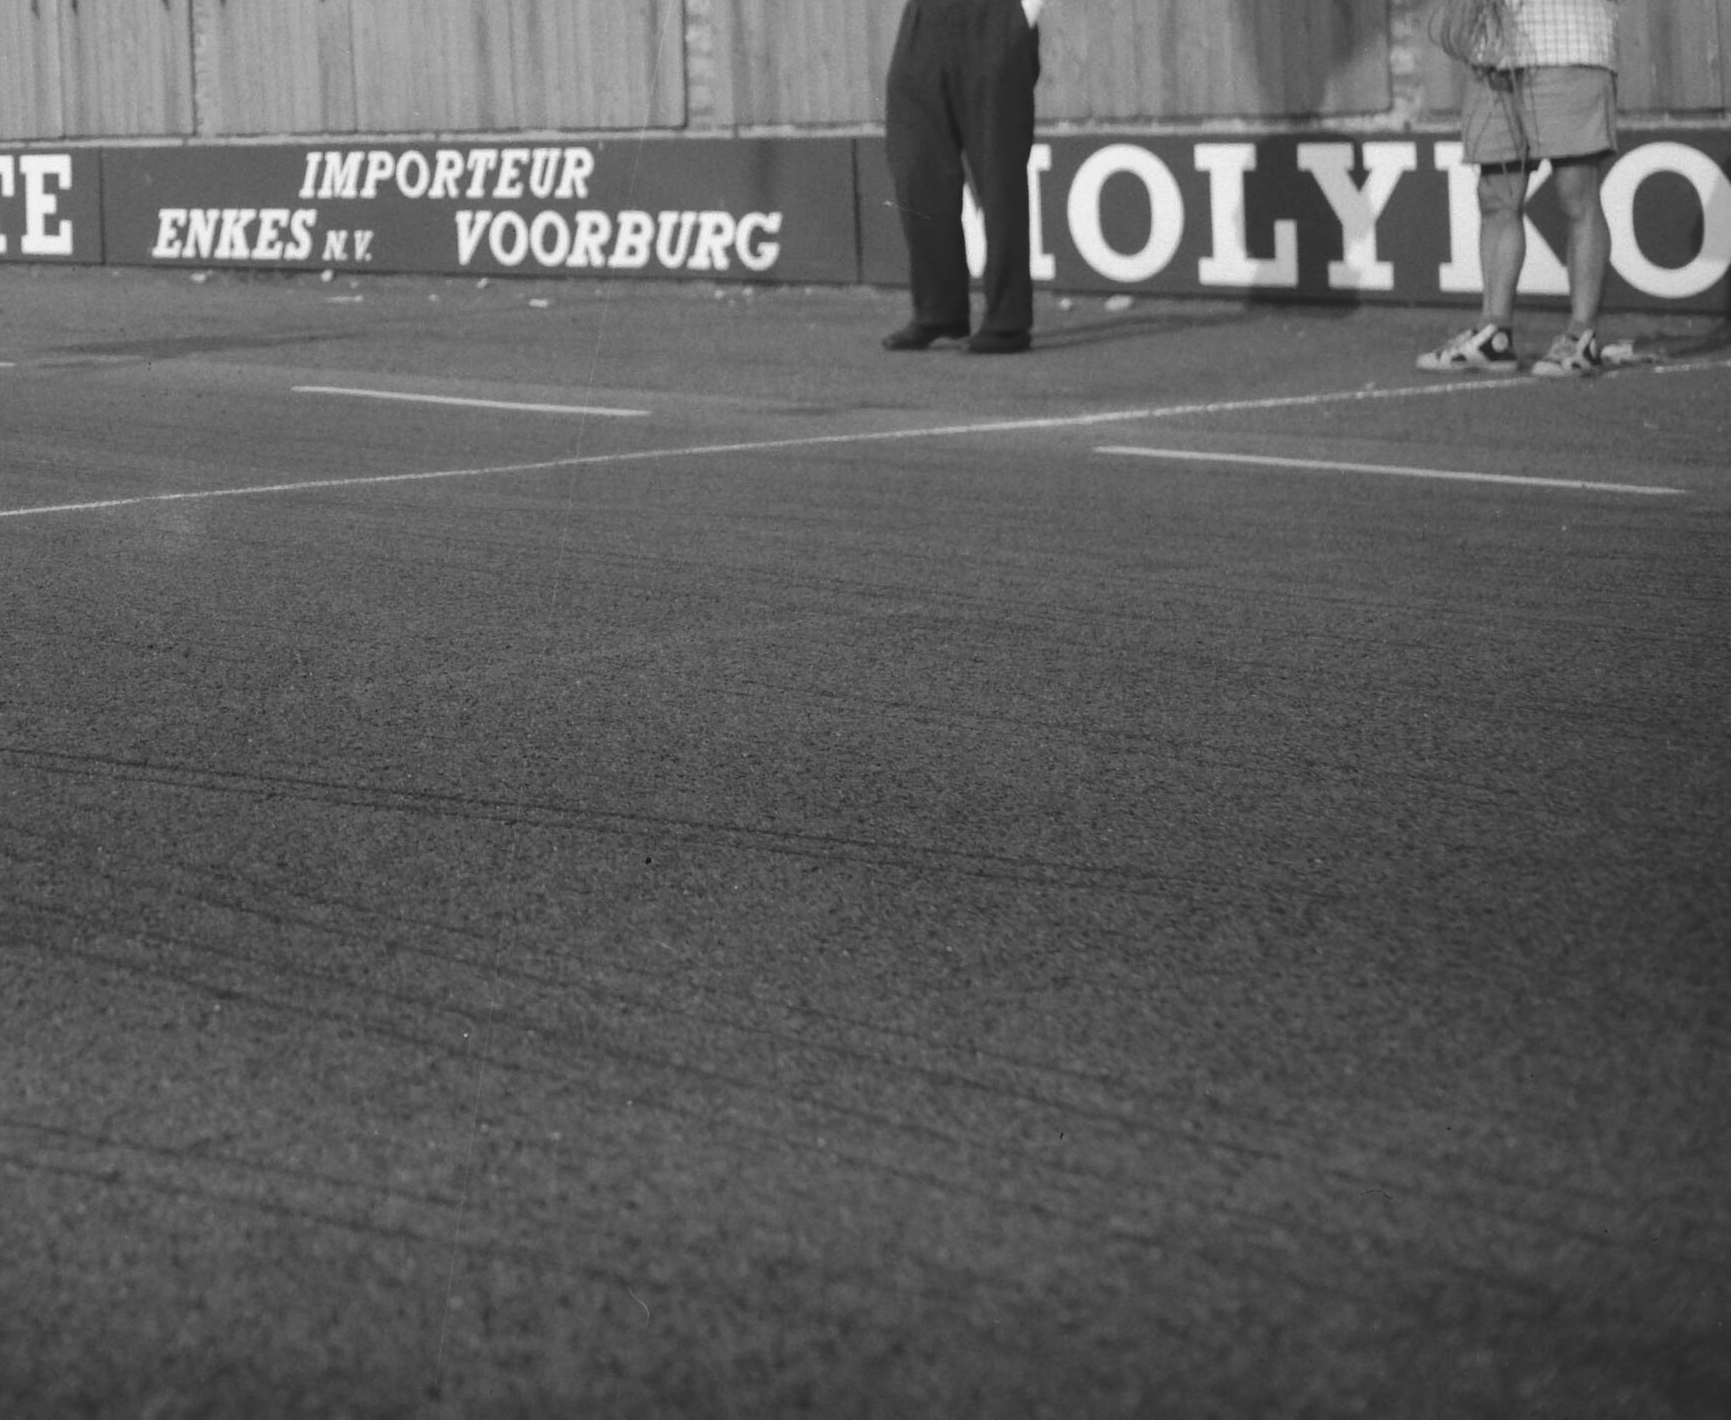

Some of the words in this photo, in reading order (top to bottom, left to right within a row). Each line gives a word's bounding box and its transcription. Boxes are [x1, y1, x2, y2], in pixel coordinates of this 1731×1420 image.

[301, 148, 596, 200] IMPORTEUR
[153, 207, 317, 262] ENKES
[455, 210, 782, 272] VOORBURG
